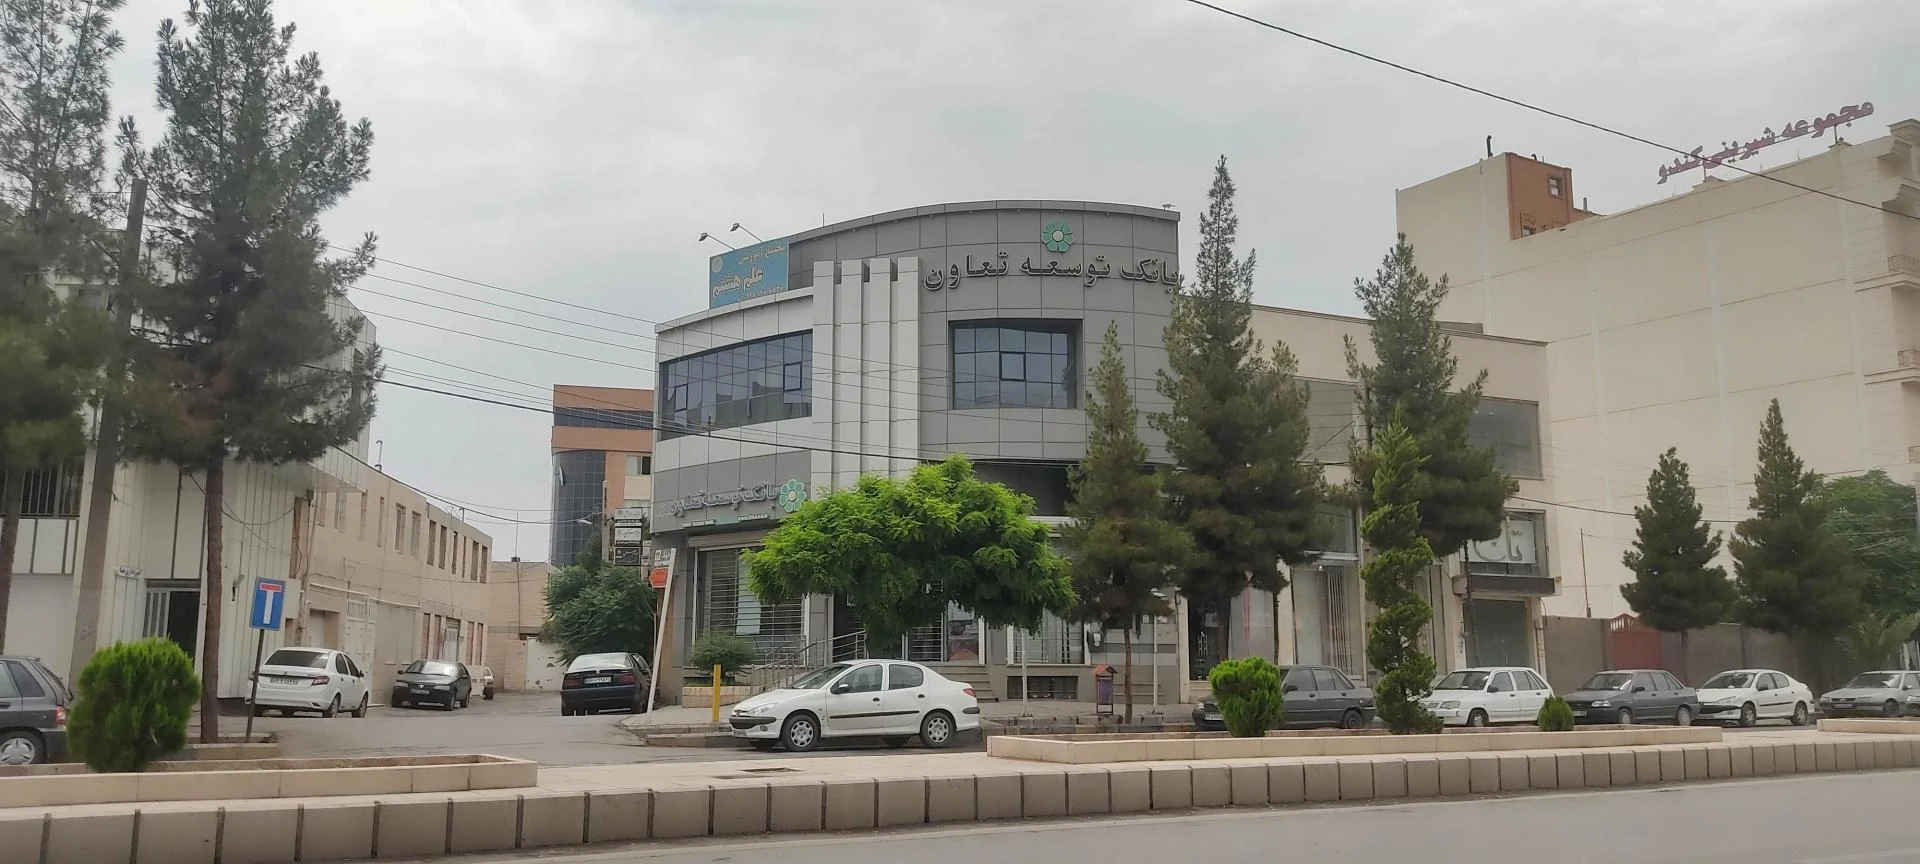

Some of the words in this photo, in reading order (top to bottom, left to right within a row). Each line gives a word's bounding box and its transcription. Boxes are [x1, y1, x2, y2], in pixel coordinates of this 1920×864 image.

[1781, 101, 1875, 139] مجموعه
[1656, 144, 1703, 185] کندو
[1703, 127, 1776, 169] شیرینی
[712, 272, 742, 299] هشتم
[923, 250, 1010, 291] تعاون
[1019, 253, 1112, 288] توسعه
[1120, 256, 1180, 294] بانک
[667, 489, 704, 517] تعاون
[702, 485, 746, 511] توسعه
[742, 481, 779, 510] بانک
